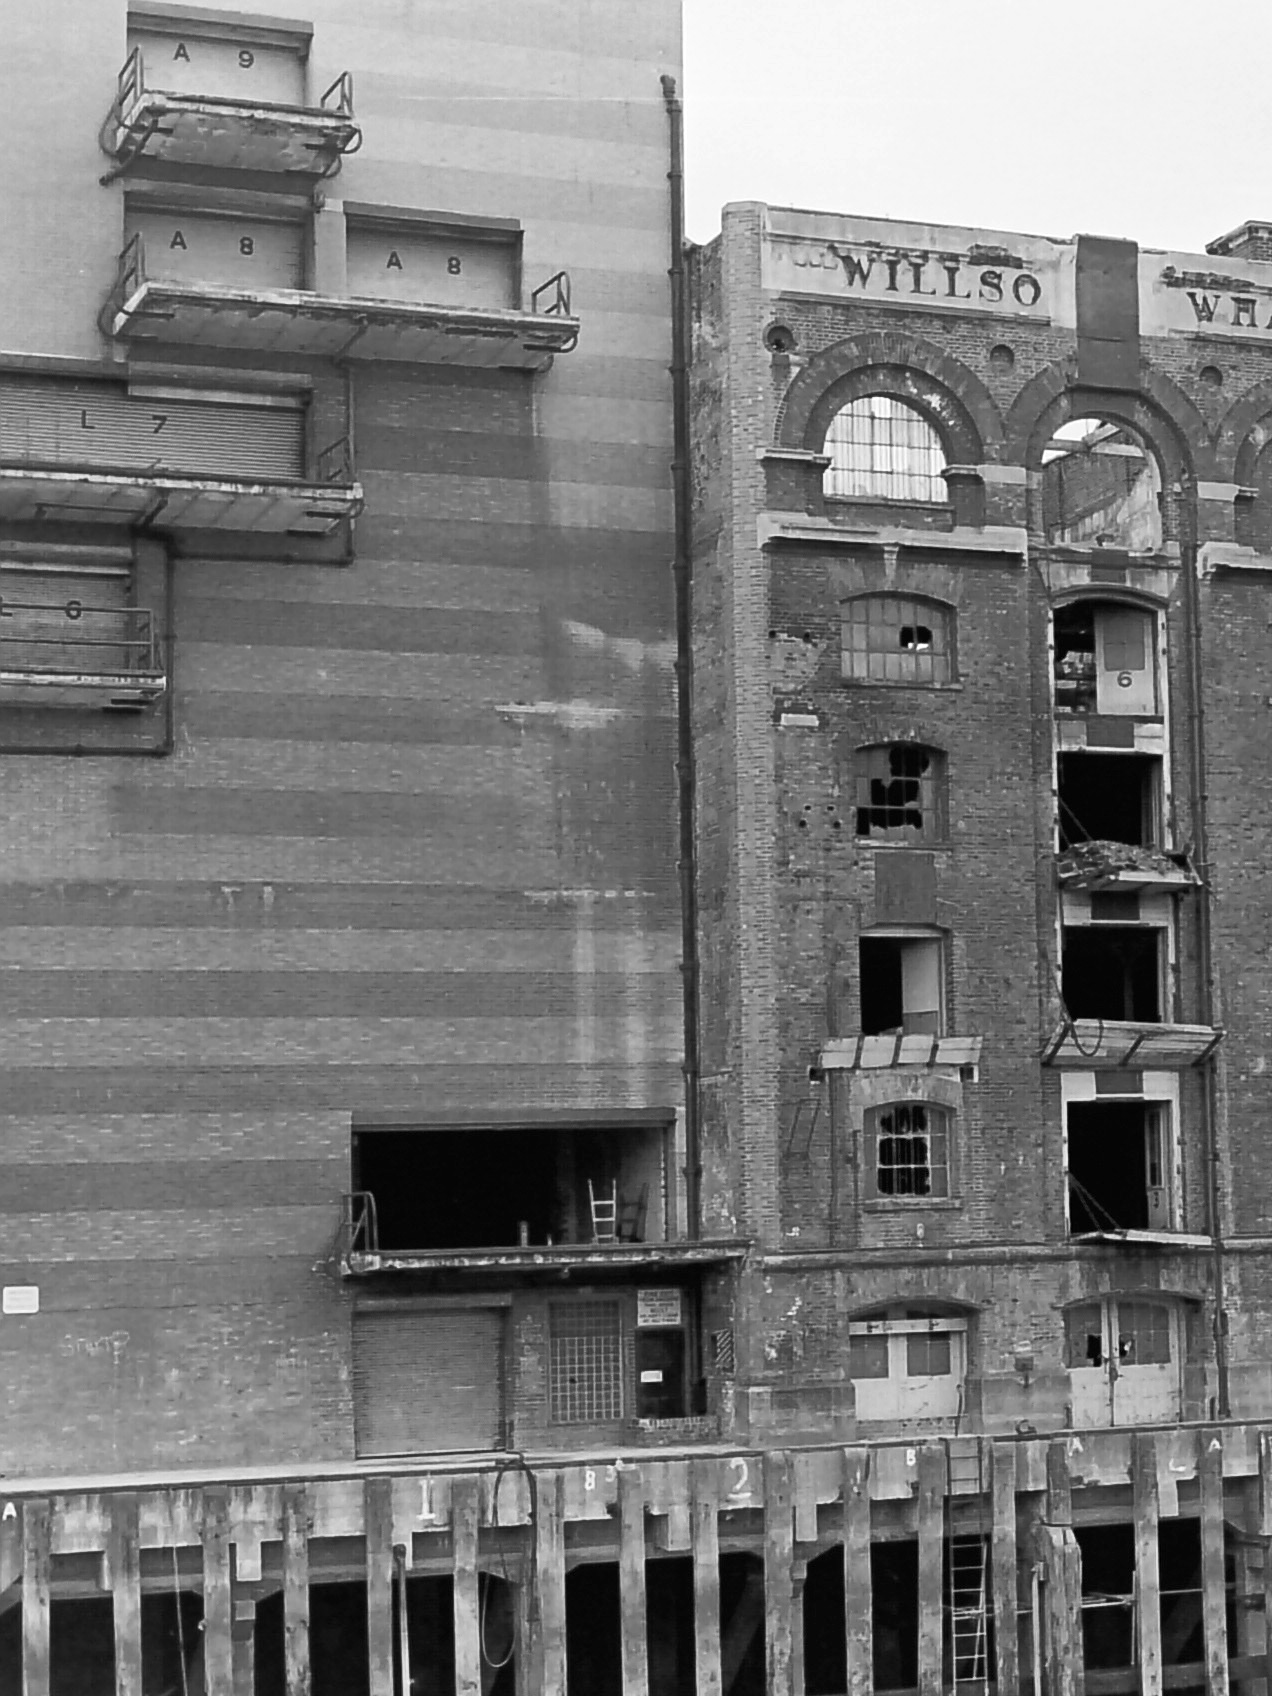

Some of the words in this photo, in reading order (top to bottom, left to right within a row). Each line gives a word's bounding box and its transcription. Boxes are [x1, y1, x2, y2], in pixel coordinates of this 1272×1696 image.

[173, 42, 191, 62] A
[238, 50, 255, 69] 9
[170, 229, 188, 251] A
[239, 235, 254, 256] 8
[386, 250, 403, 270] A
[447, 256, 461, 275] 8
[840, 250, 1042, 307] WILLSO
[81, 409, 96, 430] L
[151, 414, 168, 435] 7
[64, 599, 82, 620] 6
[1117, 670, 1133, 688] 6
[728, 1455, 752, 1499] 2
[2, 1501, 18, 1521] A
